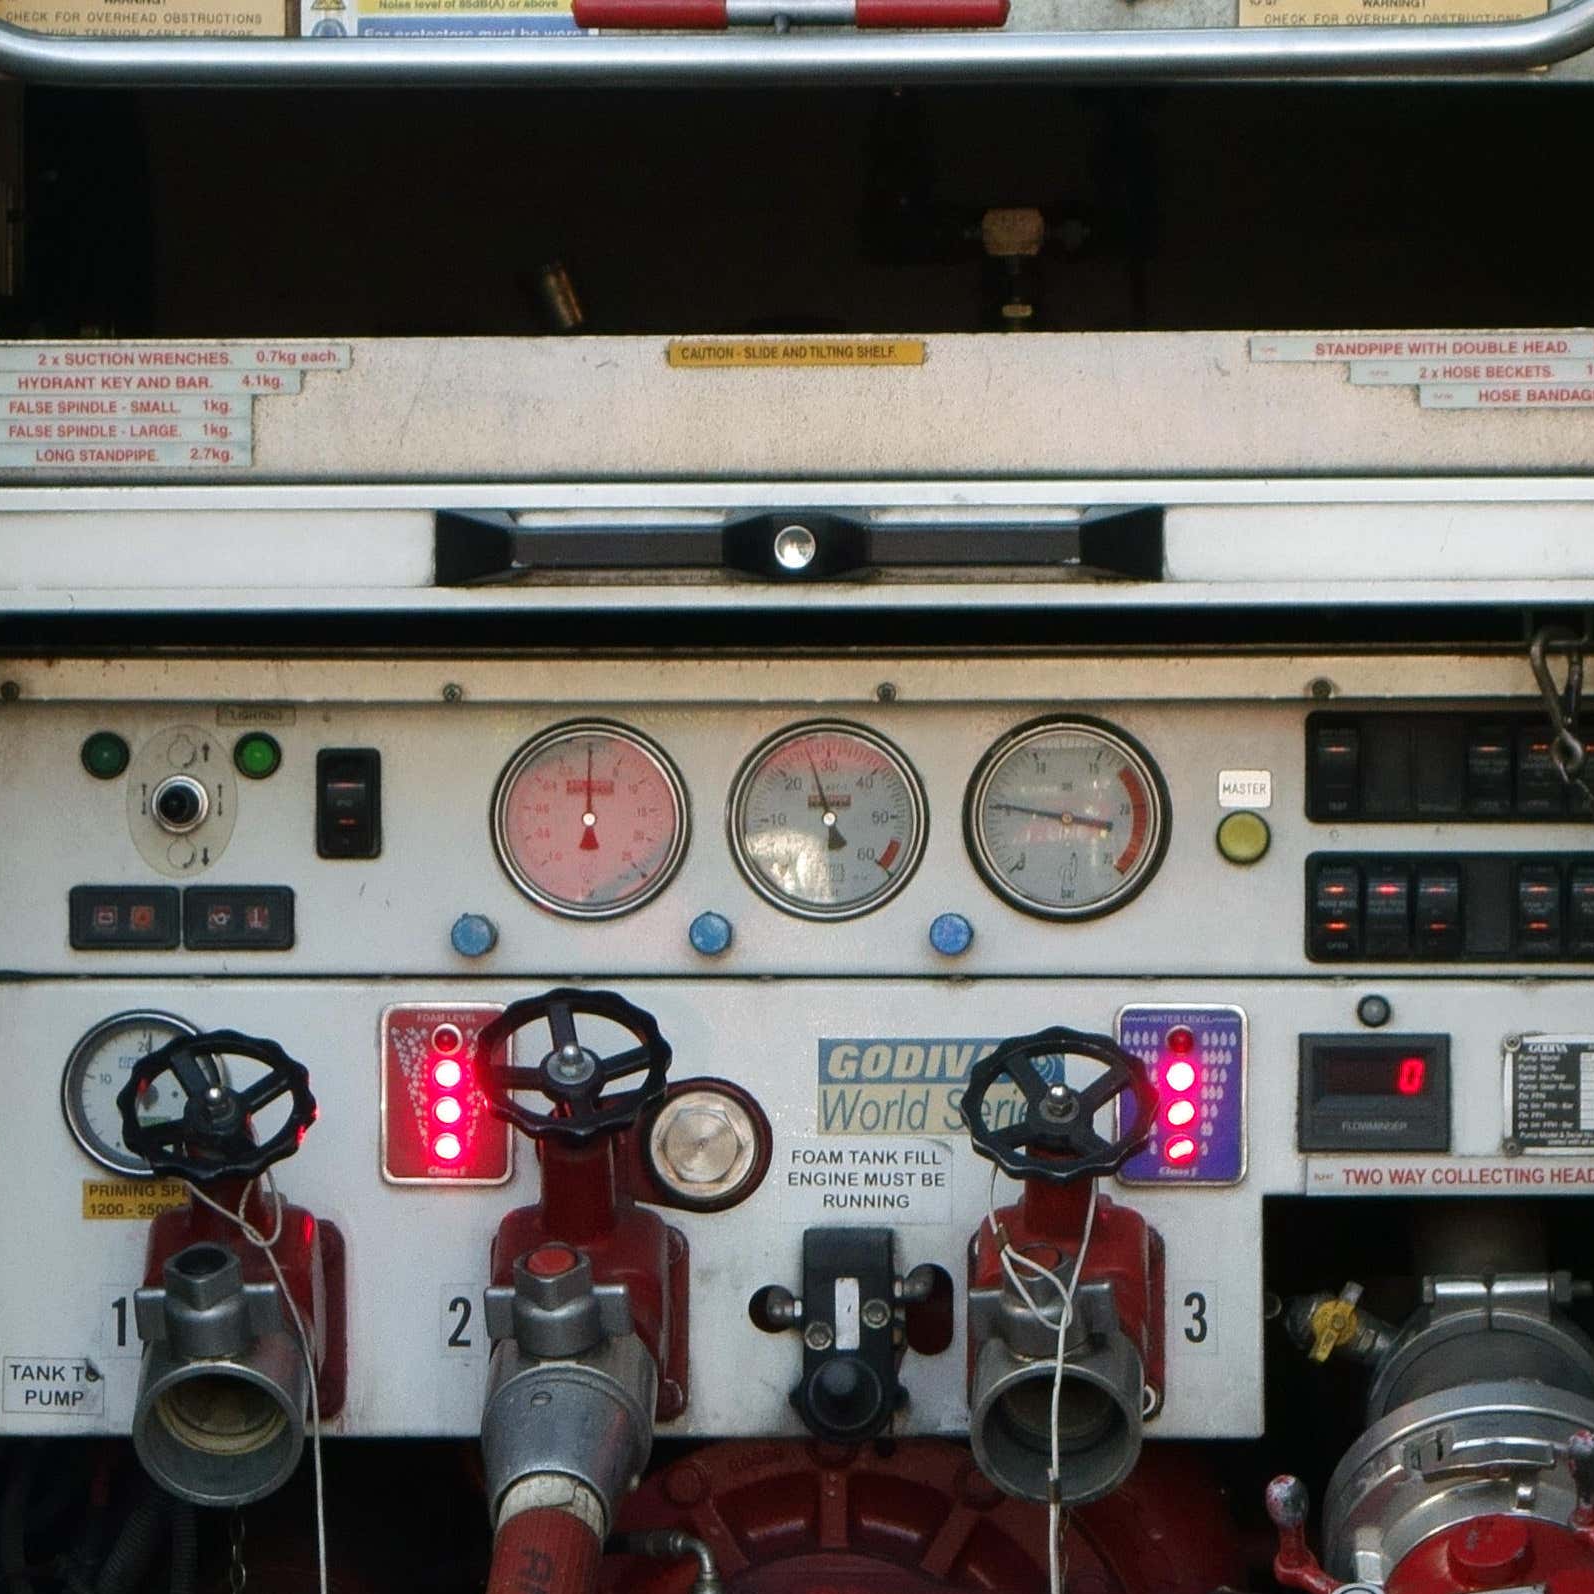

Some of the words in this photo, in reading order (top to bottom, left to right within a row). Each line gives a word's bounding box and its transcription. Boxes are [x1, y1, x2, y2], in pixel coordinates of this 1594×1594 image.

[7, 11, 47, 23] CHECK
[55, 11, 81, 23] FOR
[87, 12, 157, 23] OVERHEAD
[164, 12, 262, 24] OBSTRUCTIONS
[1264, 14, 1306, 25] CHECK
[1314, 14, 1339, 25] FOR
[681, 346, 735, 360] CAUTION
[745, 346, 778, 360] SLIDE
[782, 345, 807, 359] AND
[807, 345, 854, 359] TILTING
[1315, 341, 1404, 356] STANDPIPE
[1408, 341, 1448, 355] WITH
[1452, 340, 1520, 355] DOUBLE
[1523, 340, 1572, 354] HEAD.
[38, 353, 47, 366] 2
[51, 355, 60, 366] x
[64, 351, 135, 366] SUCTION
[139, 351, 233, 366] WRENCHES.
[256, 349, 296, 366] 0.7kg
[301, 350, 341, 363] each.
[1419, 365, 1427, 379] 2
[1429, 367, 1439, 379] x
[1442, 365, 1483, 379] HOSE
[1486, 364, 1555, 379] BECKETS.
[18, 376, 95, 391] HYDRANT
[101, 376, 135, 390] KEY
[137, 376, 171, 390] AND
[176, 376, 213, 390] BAR.
[242, 375, 284, 391] 4.1kg.
[1479, 387, 1521, 402] HOSE
[9, 400, 54, 414] FALSE
[58, 400, 118, 414] SPINDLE
[9, 424, 54, 438] FALSE
[58, 424, 118, 438] SPINDLE
[130, 424, 183, 438] LARGE.
[36, 448, 75, 463] LONG
[80, 448, 160, 463] STANDPIPE.
[189, 447, 234, 463] 2.7kg.
[821, 760, 838, 772] 30
[785, 778, 802, 791] 20
[856, 777, 873, 789] 40
[1222, 782, 1267, 796] MASTER
[771, 814, 787, 826] 10
[872, 811, 889, 824] 50
[858, 848, 875, 861] 60
[827, 1043, 998, 1081] GODIV
[99, 1073, 112, 1085] 10
[1398, 1056, 1426, 1095] 0
[822, 1087, 931, 1132] World
[791, 1149, 844, 1166] FOAM
[849, 1149, 899, 1166] TANK
[904, 1149, 943, 1165] FILL
[787, 1172, 859, 1188] ENGINE
[864, 1172, 915, 1188] MUST
[921, 1171, 946, 1187] BE
[1342, 1167, 1383, 1186] TWO
[1388, 1167, 1427, 1185] WAY
[1431, 1166, 1545, 1185] COLLECTING
[89, 1184, 157, 1198] PRIMING
[822, 1193, 911, 1209] RUNNING
[90, 1203, 125, 1217] 1200
[112, 1297, 128, 1347] 1
[447, 1297, 472, 1347] 2
[1183, 1291, 1208, 1344] 3
[9, 1366, 70, 1384] TANK
[24, 1389, 85, 1407] PUMP
